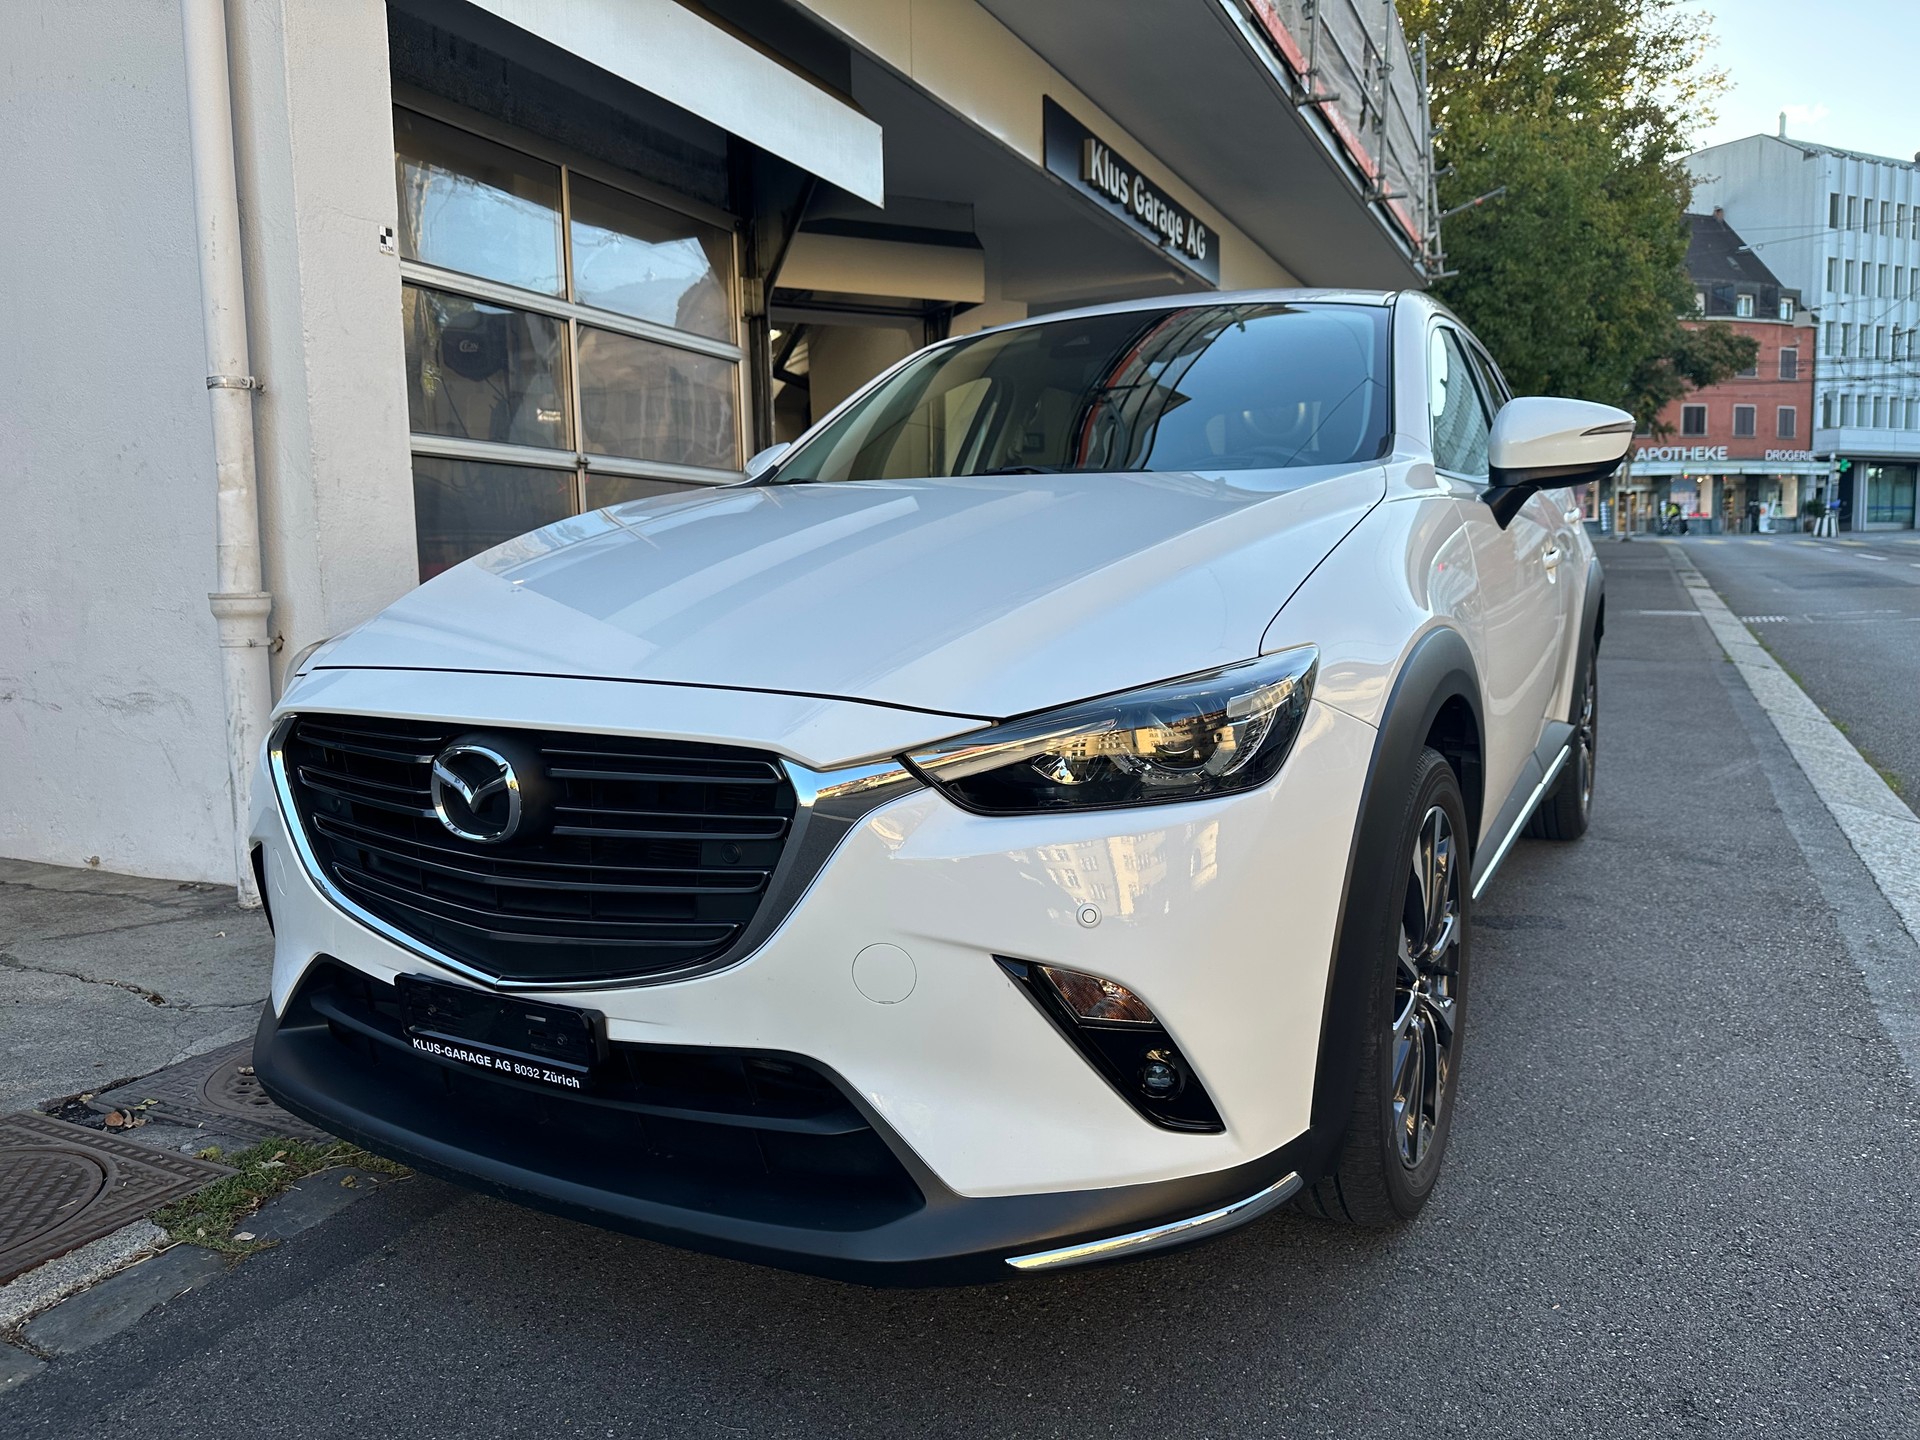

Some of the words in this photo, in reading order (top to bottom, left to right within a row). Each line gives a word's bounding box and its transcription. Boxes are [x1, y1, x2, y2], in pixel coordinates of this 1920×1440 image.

[1089, 138, 1129, 205] Klus
[1133, 174, 1184, 247] Garage
[1186, 218, 1206, 260] AG
[1634, 445, 1729, 462] APOTHEKE
[412, 1038, 493, 1067] KLUS-GARAGE
[495, 1059, 511, 1071] AG
[514, 1063, 540, 1079] 8032
[542, 1070, 580, 1088] Zürich
